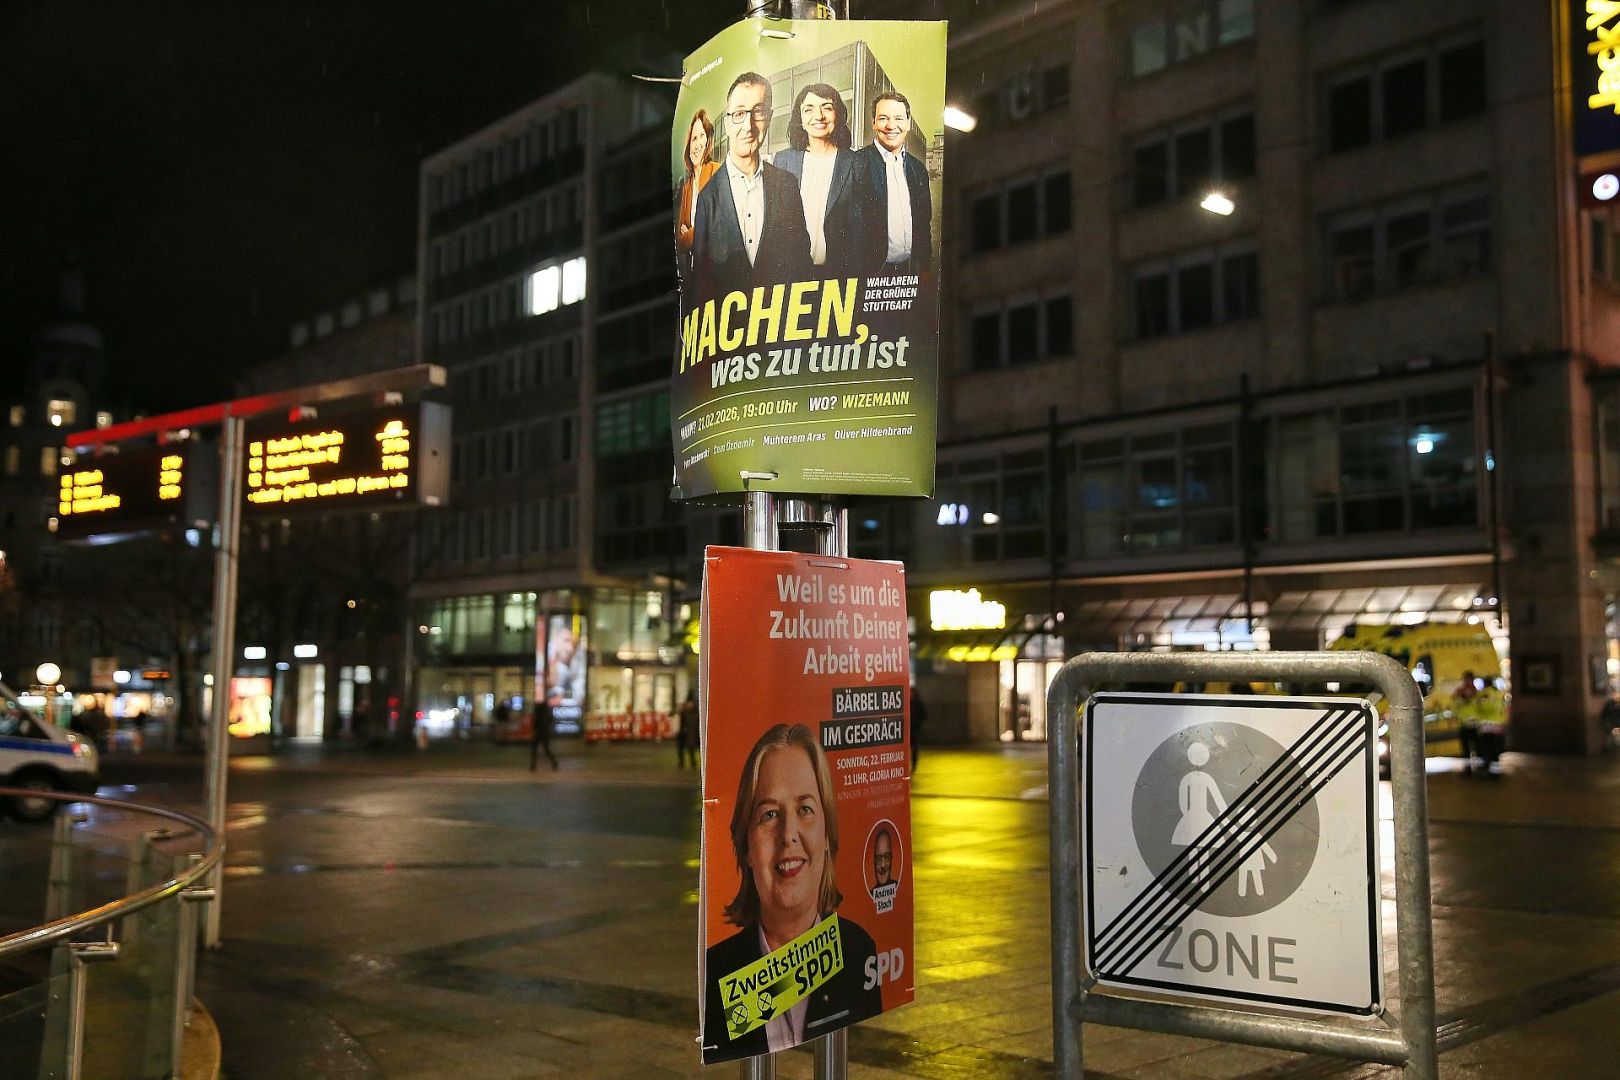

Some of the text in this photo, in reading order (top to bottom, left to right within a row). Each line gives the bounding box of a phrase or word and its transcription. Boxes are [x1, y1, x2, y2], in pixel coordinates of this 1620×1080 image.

[865, 287, 918, 300] DER GRÜNEN
[867, 276, 918, 287] WAHLARENA
[863, 300, 912, 312] STUTTGART
[680, 278, 868, 375] MACHEN,
[711, 335, 909, 389] was zu tun ist
[743, 402, 774, 418] 19:00
[776, 399, 798, 414] Uhr
[809, 395, 837, 412] WO?
[843, 391, 909, 409] WIZEMANN
[763, 432, 826, 446] Muhterem Aras
[834, 425, 913, 440] Oliver Hildenbrand
[776, 574, 900, 607] Weil es um die
[769, 610, 901, 639] Zukunft Deiner
[803, 646, 903, 682] Arbeit geht!
[836, 689, 902, 713] BÄRBEL BAS
[823, 718, 902, 747] IM GESPRÄCH
[837, 751, 904, 770] SONNTAG, 22. FEBRUAR
[843, 767, 904, 786] 11 UHR, GLORIA KINO
[874, 887, 895, 899] Andreas
[726, 924, 837, 1002] Zweitstimme
[794, 940, 841, 996] SPD!
[1157, 925, 1298, 984] ZONE
[863, 947, 905, 991] SPD
